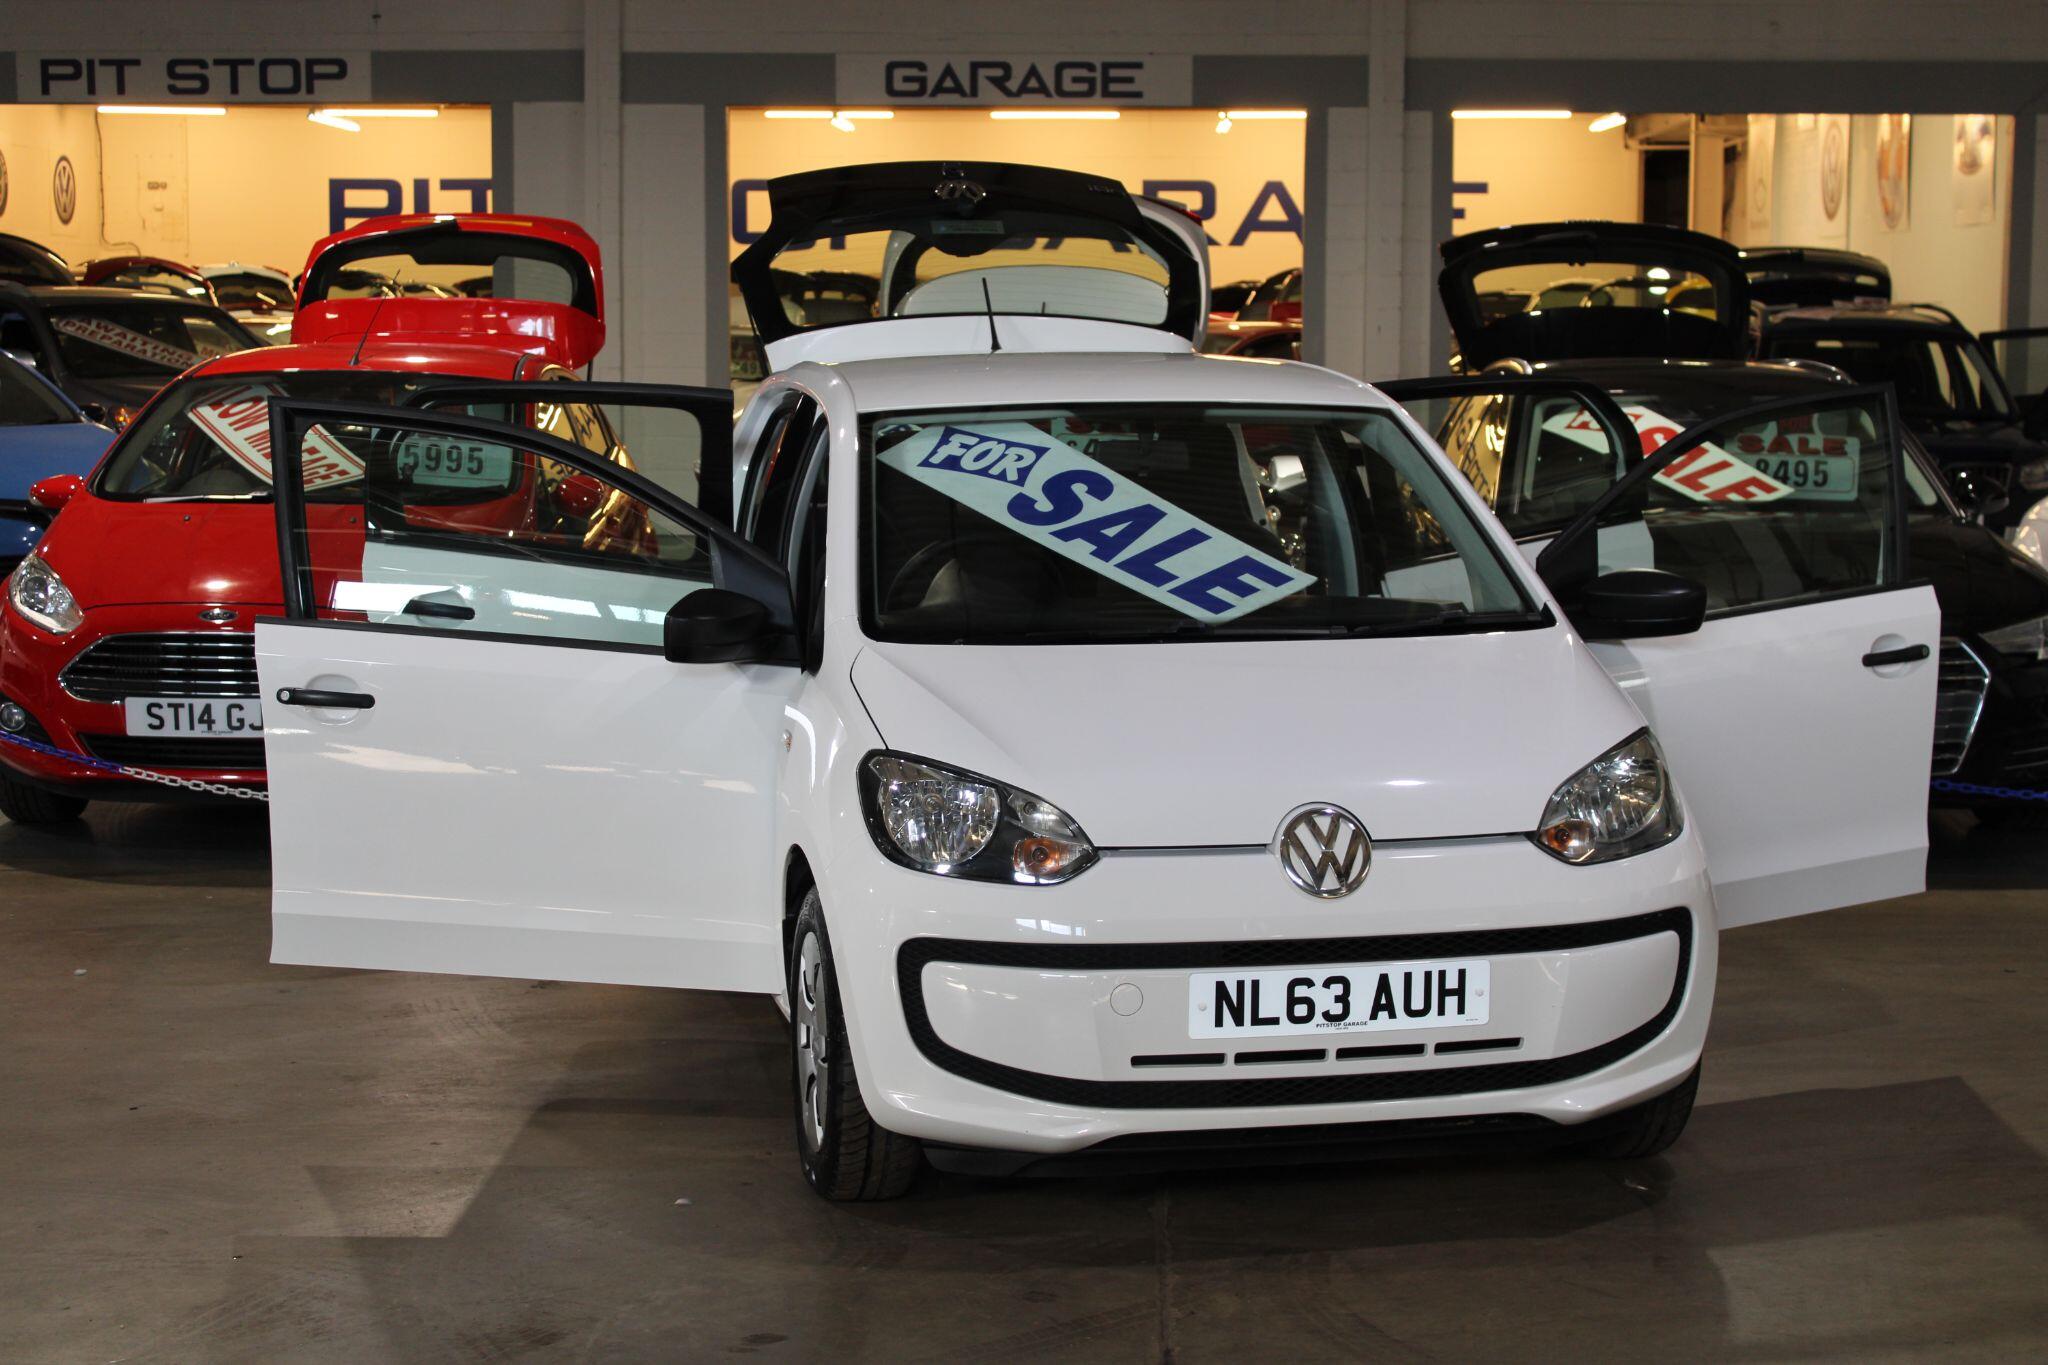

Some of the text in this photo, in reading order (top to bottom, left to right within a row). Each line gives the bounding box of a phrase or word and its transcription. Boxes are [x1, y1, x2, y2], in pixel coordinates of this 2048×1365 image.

[40, 57, 348, 96] PIT STOP
[885, 60, 1143, 99] GARAGE
[62, 319, 194, 369] PREPARATION
[80, 317, 194, 362] AWAITING
[403, 443, 484, 476] 5995
[928, 433, 1037, 487] FOR
[1736, 433, 1849, 456] SALE
[1006, 469, 1296, 616] SALE
[146, 702, 264, 731] ST14 GJ
[1214, 967, 1467, 1029] NL63 AUH
